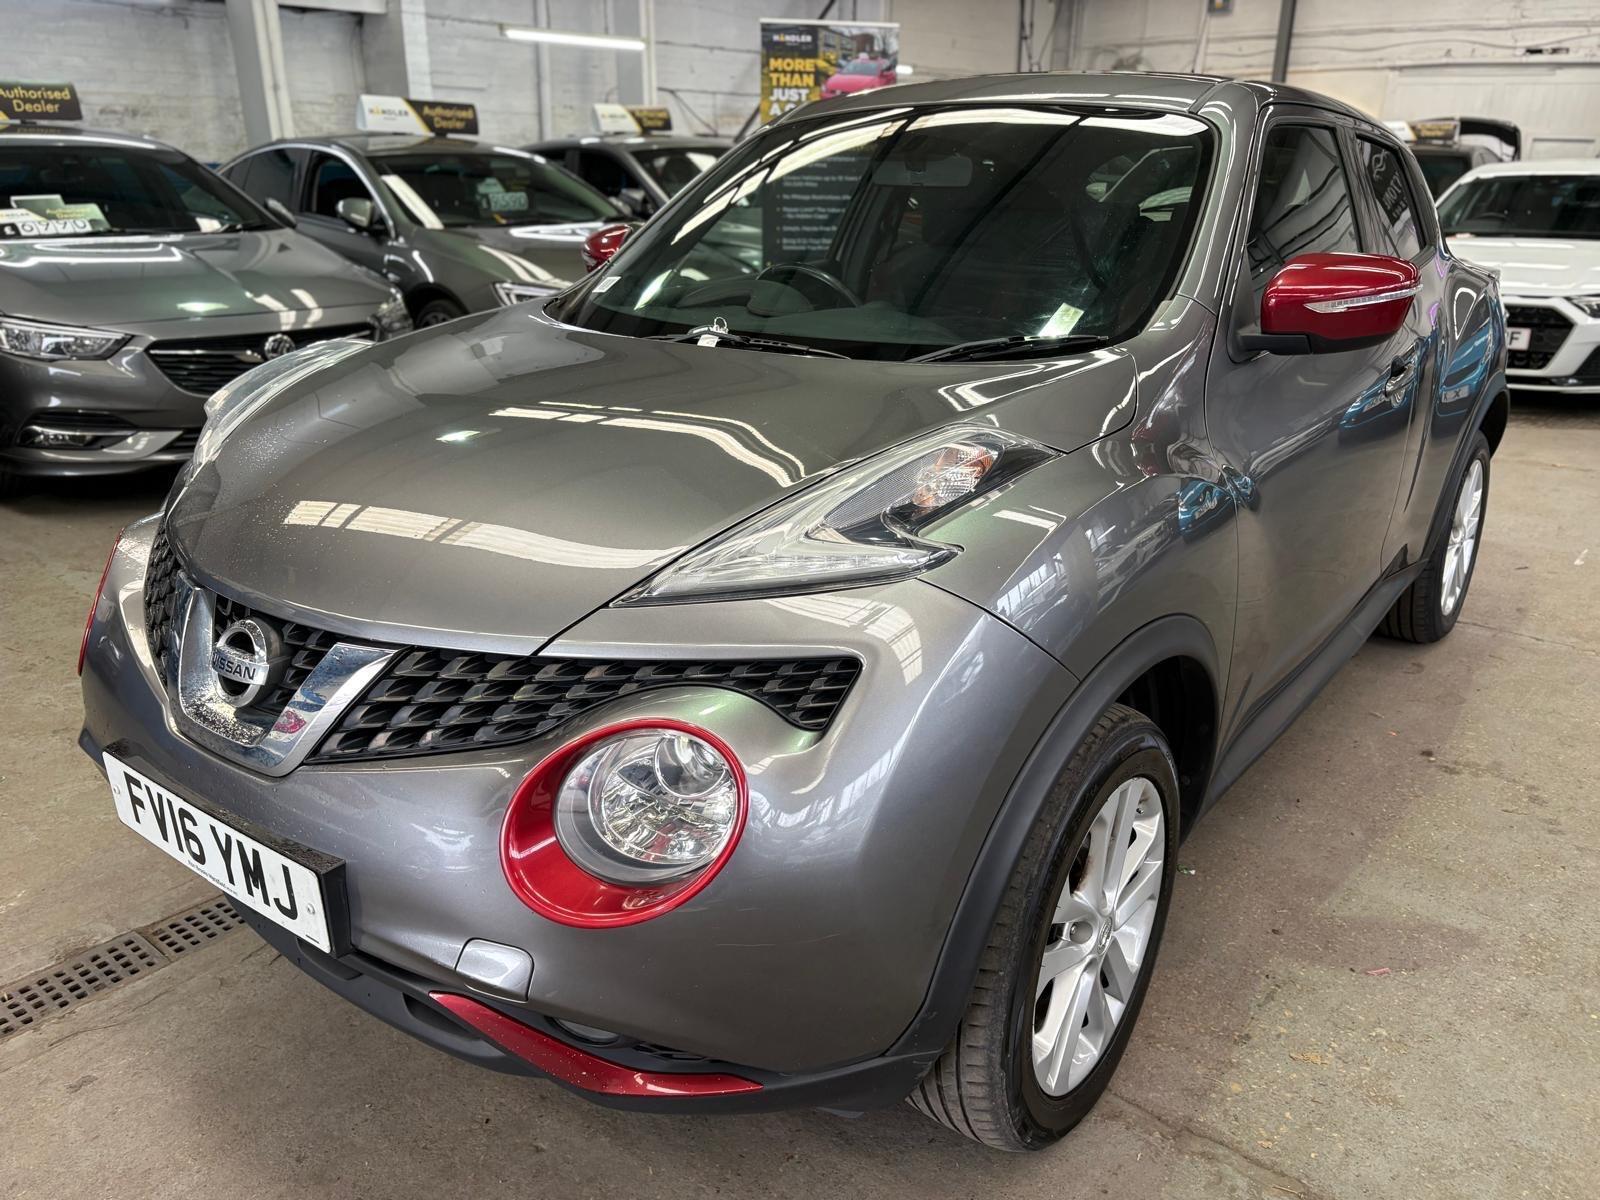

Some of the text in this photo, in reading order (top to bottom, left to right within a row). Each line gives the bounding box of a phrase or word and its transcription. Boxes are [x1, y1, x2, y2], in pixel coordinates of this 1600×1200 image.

[769, 57, 816, 71] MORE
[769, 72, 815, 87] THAN
[0, 86, 71, 100] Authorised
[769, 88, 809, 101] JUST
[12, 99, 60, 113] Dealer
[769, 102, 782, 116] A
[212, 650, 256, 681] NISSAN
[123, 771, 298, 921] FV16 YMJ
